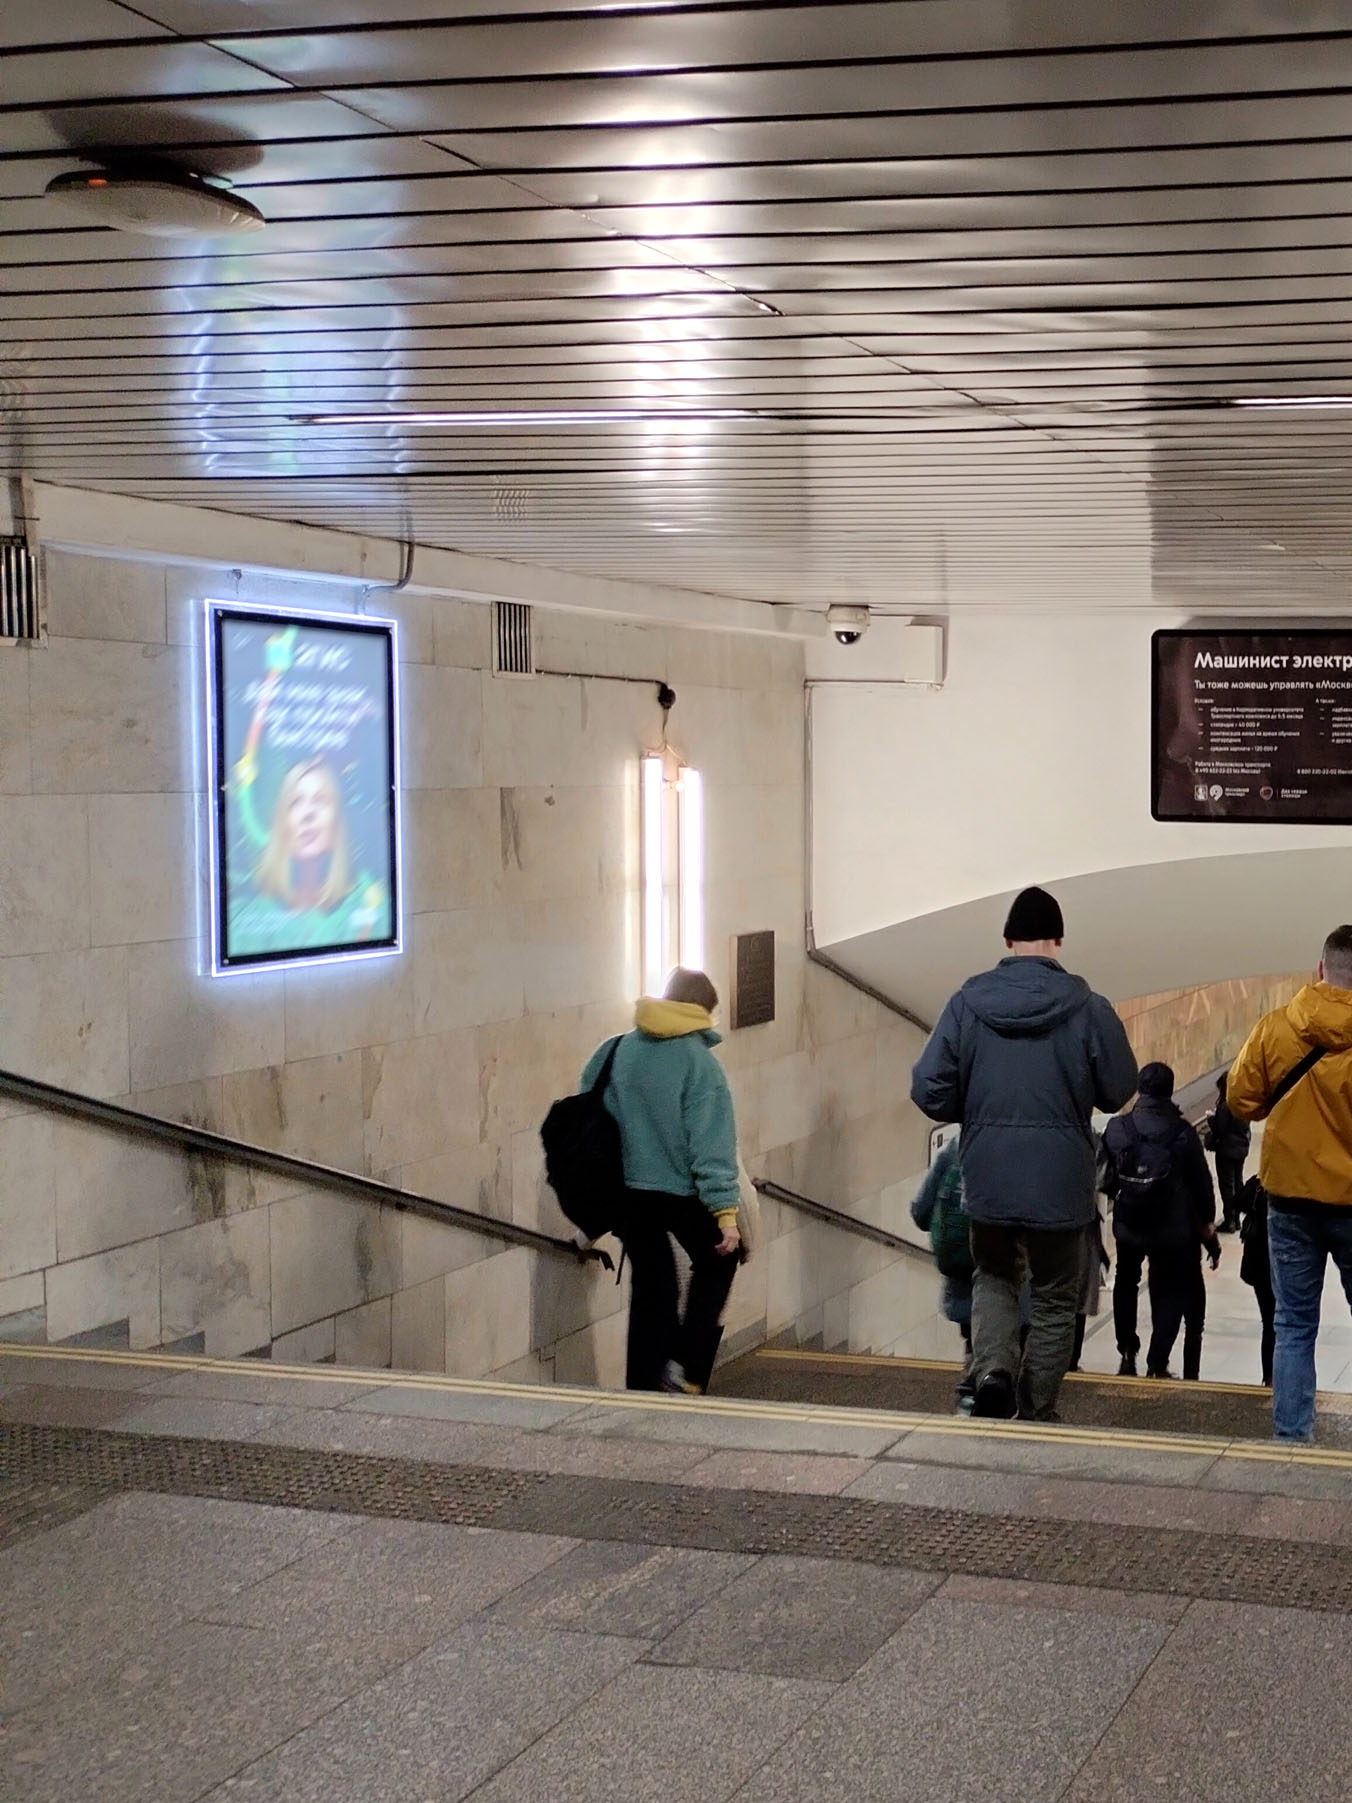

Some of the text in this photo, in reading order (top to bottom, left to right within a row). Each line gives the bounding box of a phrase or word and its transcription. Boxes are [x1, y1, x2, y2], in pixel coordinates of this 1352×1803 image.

[1194, 651, 1289, 669] Машинист
[1194, 680, 1206, 689] Ты
[1207, 681, 1229, 689] тоже
[1231, 681, 1268, 689] можешь
[1269, 681, 1314, 691] управлять
